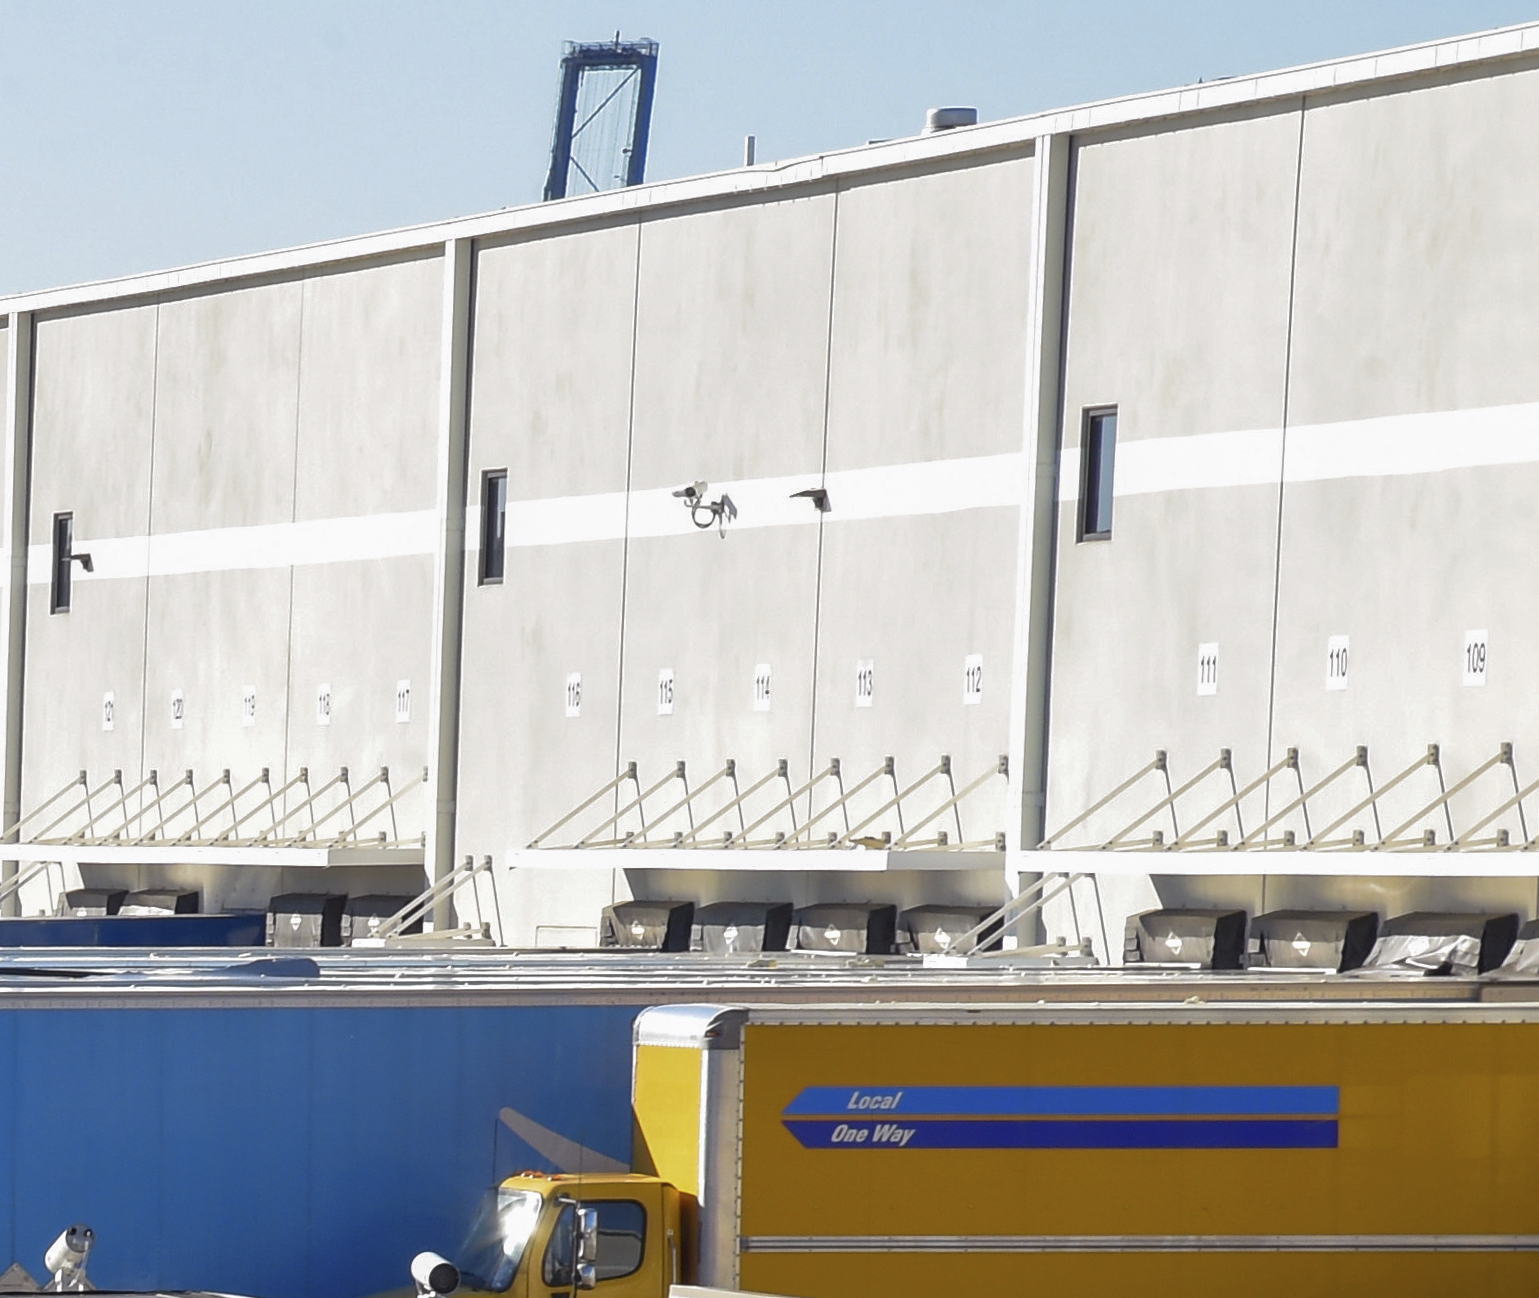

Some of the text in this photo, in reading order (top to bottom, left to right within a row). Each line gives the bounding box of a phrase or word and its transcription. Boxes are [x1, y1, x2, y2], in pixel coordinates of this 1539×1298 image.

[1200, 655, 1217, 683] 111
[1329, 648, 1348, 677] 110
[1466, 642, 1486, 673] 109
[659, 679, 673, 703] 115
[756, 676, 770, 700] 114
[858, 670, 873, 696] 113
[966, 666, 982, 693] 112
[567, 682, 581, 707] 116
[847, 1091, 903, 1109] Local
[831, 1124, 916, 1147] One Way
